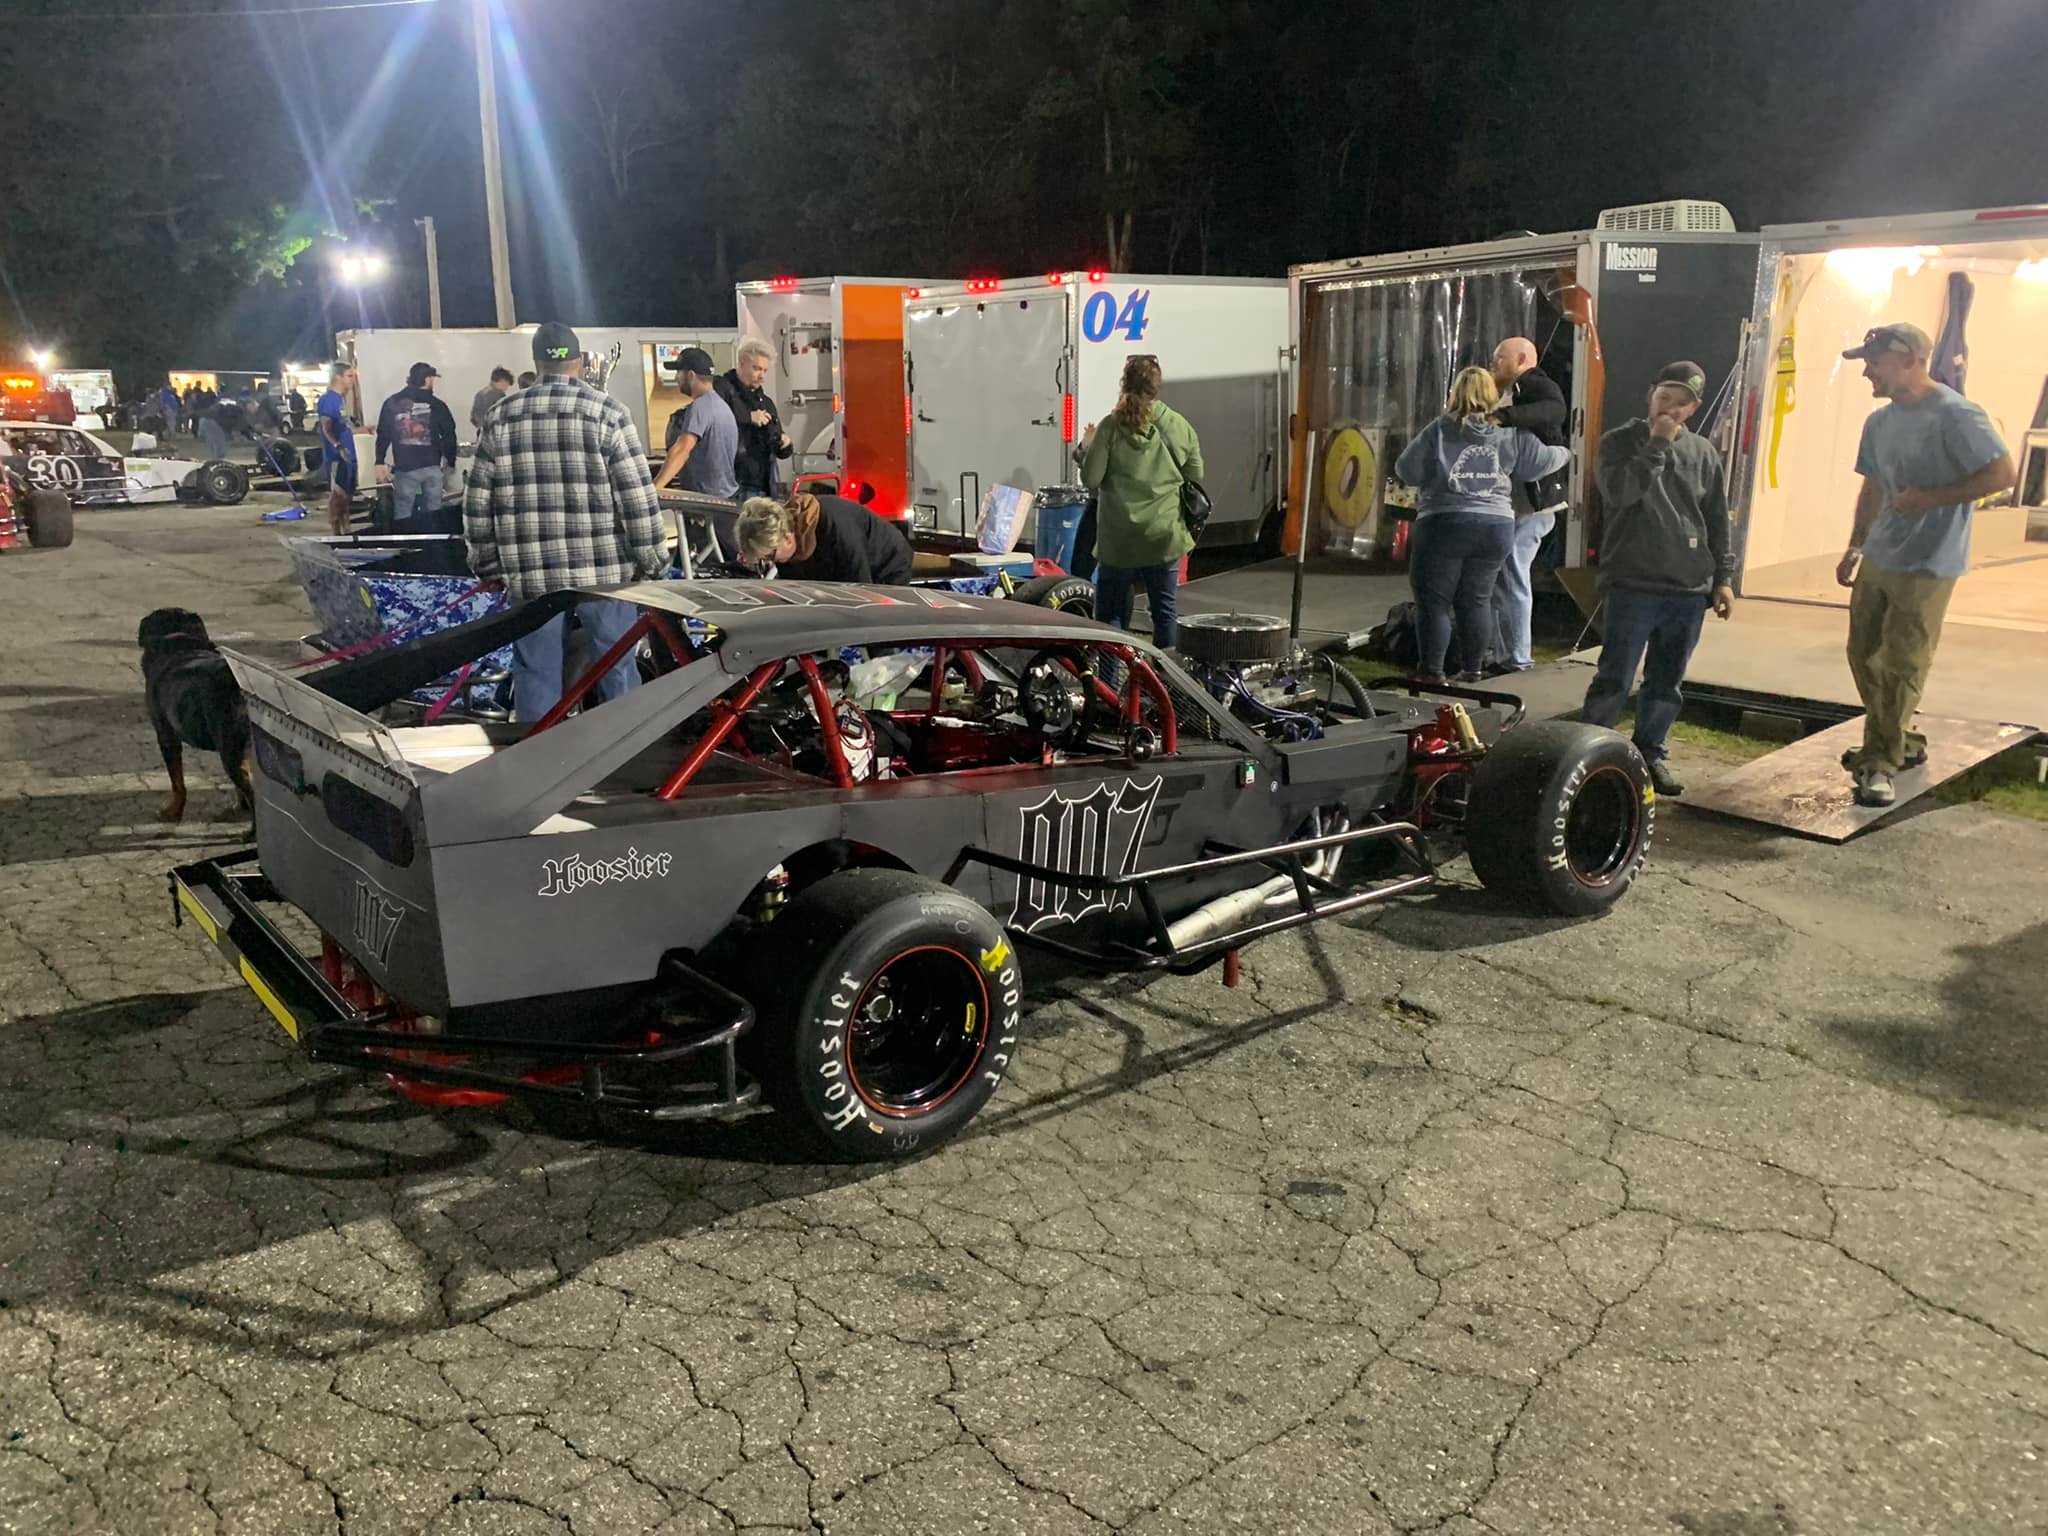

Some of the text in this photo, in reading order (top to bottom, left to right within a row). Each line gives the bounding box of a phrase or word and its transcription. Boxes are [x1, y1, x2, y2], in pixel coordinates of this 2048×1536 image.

[1082, 288, 1150, 343] 04
[28, 455, 83, 491] 30
[538, 847, 673, 896] Hoosier
[1008, 775, 1164, 933] 007
